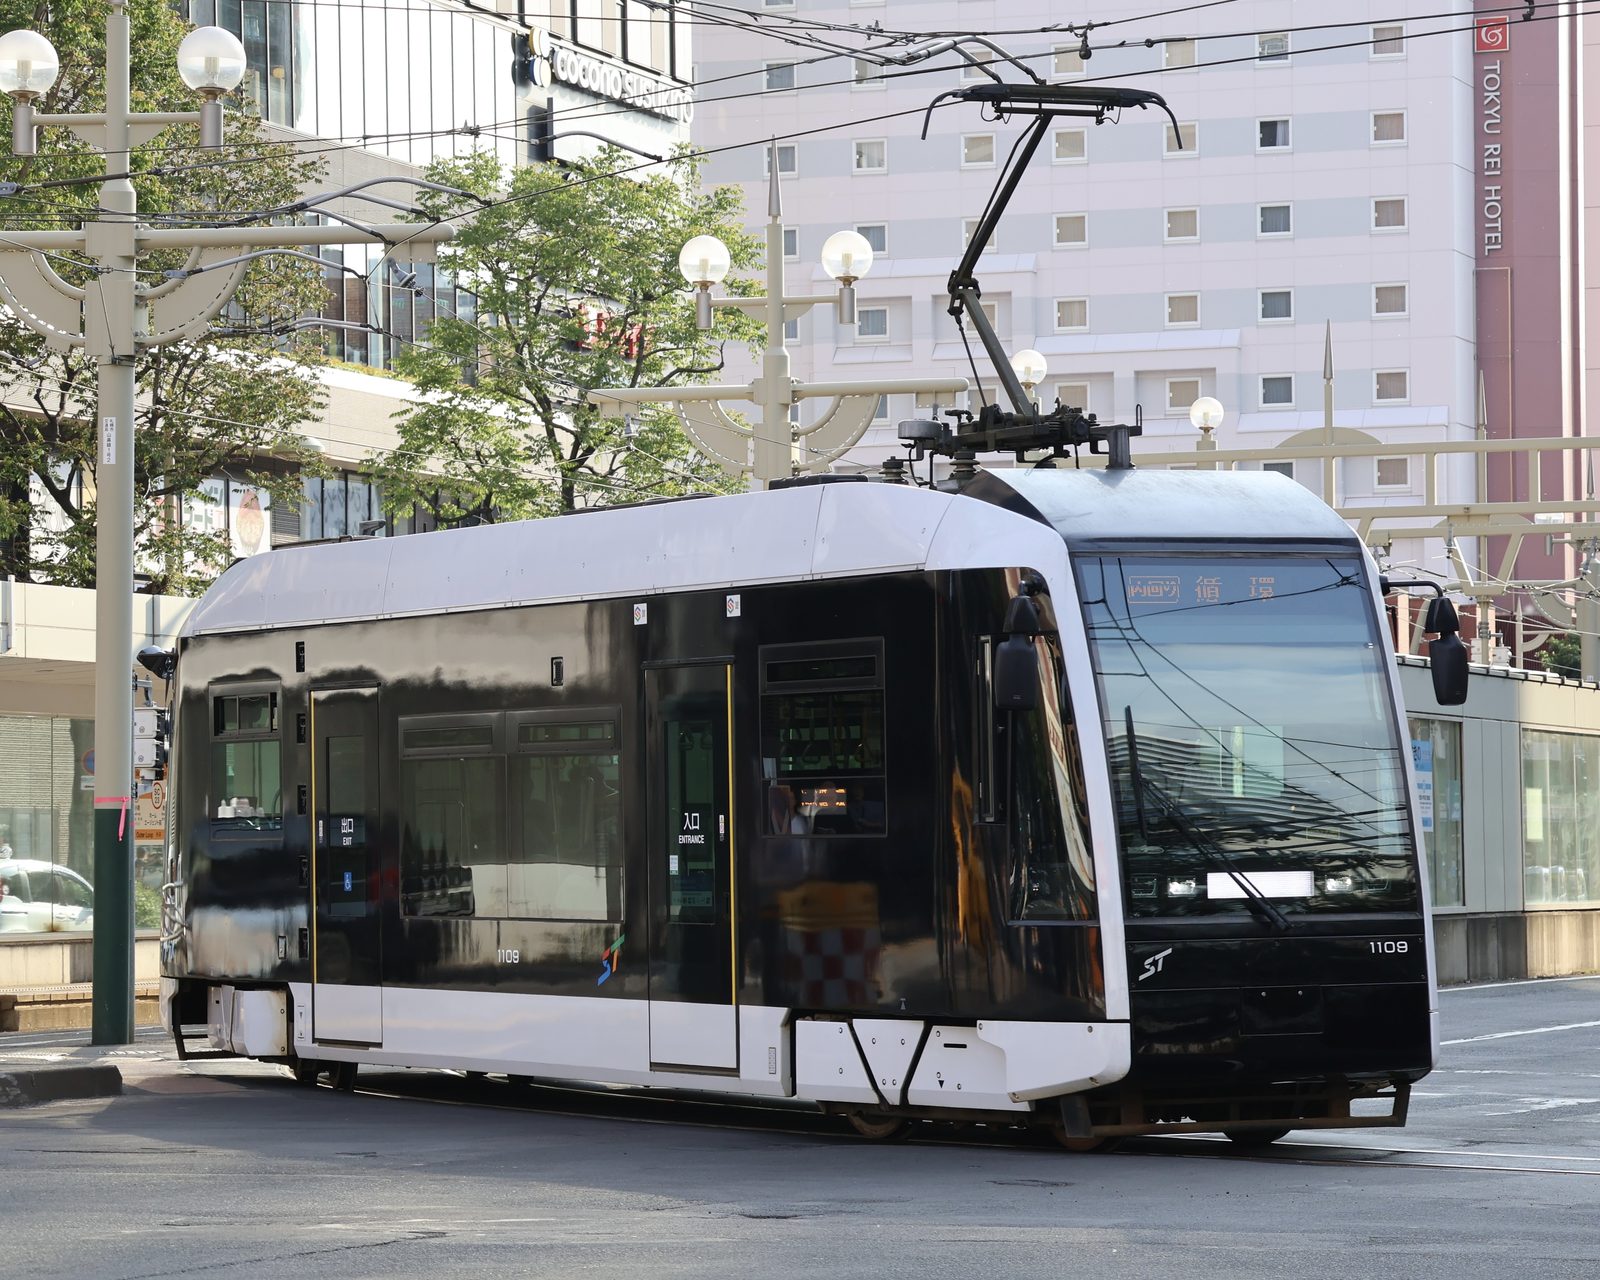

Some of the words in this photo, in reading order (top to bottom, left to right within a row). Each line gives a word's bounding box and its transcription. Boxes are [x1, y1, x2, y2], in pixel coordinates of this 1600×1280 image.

[1483, 60, 1501, 134] TOKYU
[1484, 143, 1501, 176] REI
[1484, 185, 1502, 256] HOTEL
[341, 817, 354, 833] 出口
[683, 812, 700, 831] 入口
[342, 836, 352, 846] EXIT
[678, 834, 705, 845] ENTRANCE
[1369, 941, 1409, 954] 1109
[497, 949, 520, 964] 1109
